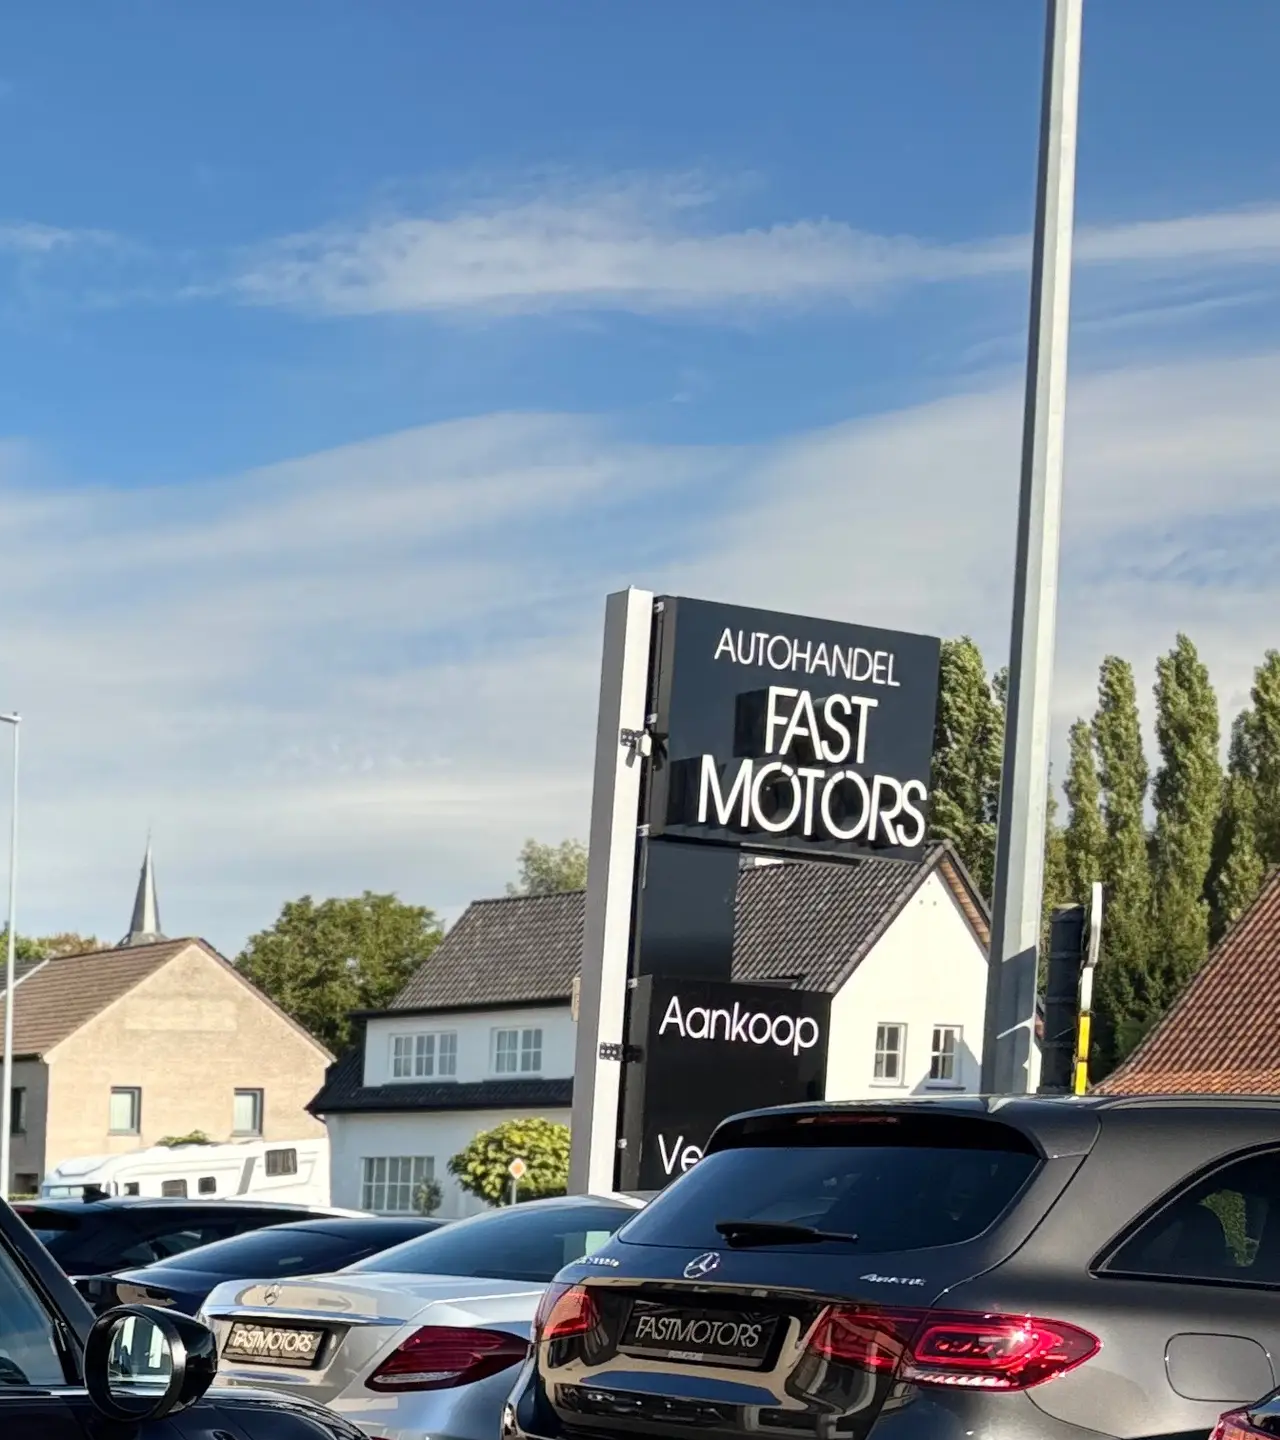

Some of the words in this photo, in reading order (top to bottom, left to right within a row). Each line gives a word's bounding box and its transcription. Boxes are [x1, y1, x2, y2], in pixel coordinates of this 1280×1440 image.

[714, 628, 901, 686] AUTOHANDEL
[765, 686, 879, 764] FAST
[698, 755, 928, 848] MOTORS
[659, 996, 819, 1056] Aankoop
[233, 1330, 313, 1352] FASTMOTORS
[635, 1316, 762, 1348] FASTMOTORS
